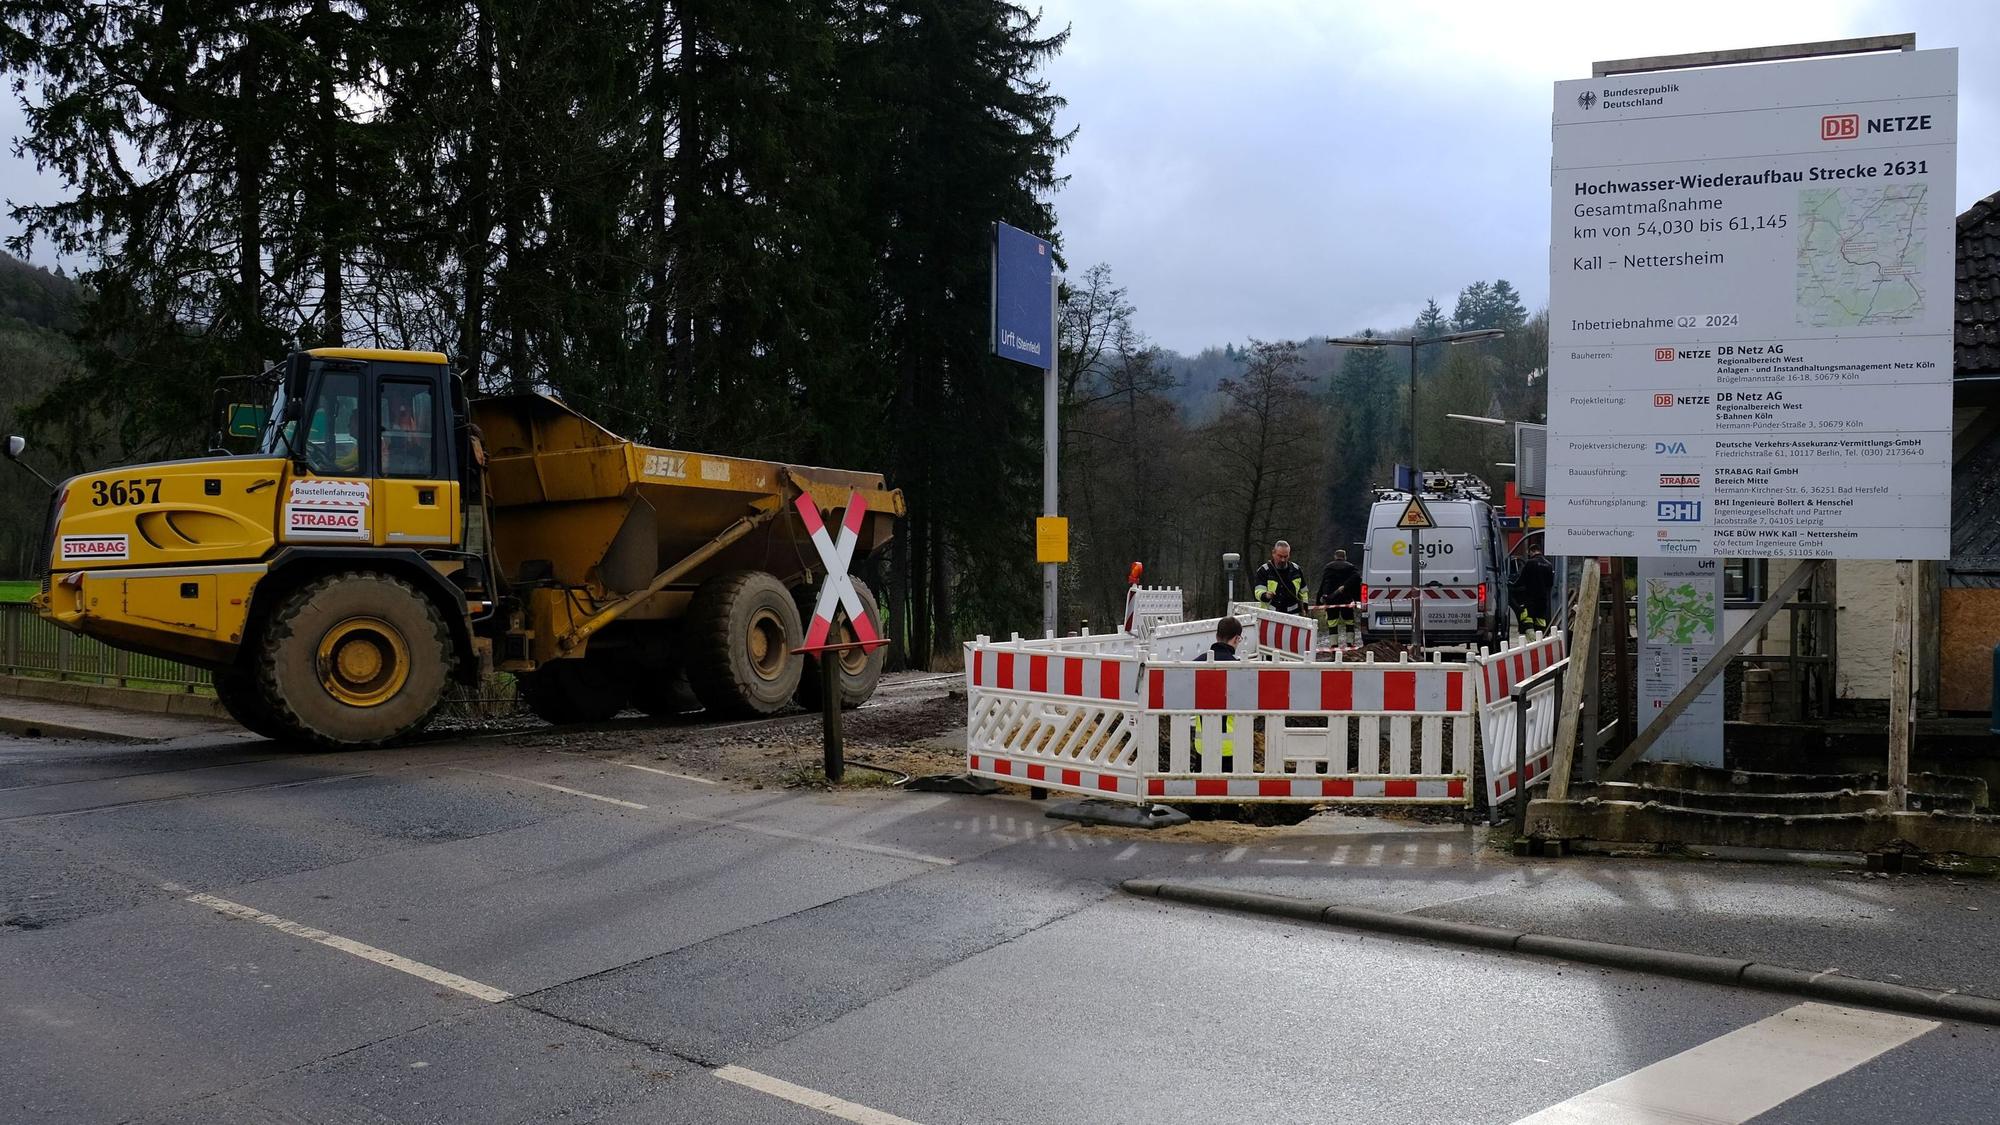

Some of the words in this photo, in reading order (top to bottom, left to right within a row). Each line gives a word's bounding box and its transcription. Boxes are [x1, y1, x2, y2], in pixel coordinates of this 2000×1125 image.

[1603, 84, 1680, 98] Bundesrepublik
[1603, 96, 1663, 110] Deutschland
[1826, 118, 1855, 137] DB
[1866, 115, 1932, 134] NETZE
[1574, 169, 1803, 196] Hochwasser-Wiederaufbau
[1809, 164, 1877, 182] Strecke
[1883, 160, 1929, 176] 2631
[1574, 196, 1723, 218] Gesamtmaßnahme
[1574, 224, 1597, 240] km
[1603, 224, 1631, 238] von
[1636, 219, 1694, 237] 54,030
[1700, 216, 1723, 233] bis
[1728, 213, 1788, 232] 61,145
[1573, 255, 1603, 271] Kall
[1623, 251, 1724, 269] Nettersheim
[1571, 316, 1674, 332] Inbetriebnahme
[1677, 315, 1697, 330] Q2
[1706, 313, 1738, 328] 2024
[1001, 328, 1016, 348] Urft
[1016, 336, 1041, 356] (Steinfeld)
[1657, 350, 1672, 360] DB
[1678, 350, 1711, 358] NETZE
[1718, 346, 1734, 356] DB
[1738, 346, 1764, 355] Netz
[1767, 345, 1784, 354] AG
[1571, 352, 1613, 360] Bauherren:
[1717, 357, 1782, 365] Regionalbereich
[1717, 366, 1749, 374] Anlagen
[1774, 363, 1892, 373] Instandhaltungsmanagement
[1717, 374, 1785, 384] Brügelmannstraße
[1788, 374, 1812, 382] 16-18,
[1815, 373, 1840, 381] 50679
[1656, 396, 1672, 406] DB
[1677, 396, 1710, 404] NETZE
[1717, 393, 1733, 402] DB
[1736, 392, 1763, 401] Netz
[1766, 392, 1783, 401] AG
[1716, 403, 1781, 412] Regionalbereich
[1716, 421, 1806, 430] Hermann-Pünder-Straße
[1846, 420, 1863, 428] Köln
[1569, 442, 1648, 450] Projektversicherung:
[1755, 439, 1921, 448] Verkehrs-Assekuranz-Vermittlungs-GmbH
[1716, 449, 1773, 457] Friedrichstraße
[1775, 450, 1788, 458] 61,
[1790, 449, 1814, 457] 10117
[1817, 449, 1842, 458] Berlin,
[1861, 448, 1883, 457] (030)
[1886, 448, 1924, 456] 217364-0
[643, 454, 687, 480] BELL
[1715, 477, 1745, 485] Bereich
[91, 478, 162, 507] 3657
[294, 487, 366, 501] Baustellenfahrzeug
[1715, 486, 1799, 494] Hermann-Kirchner-Str.
[1811, 486, 1835, 494] 36251
[1838, 486, 1852, 494] Bad
[1855, 486, 1888, 494] Hersfeld
[1732, 499, 1775, 507] Ingenieure
[1714, 508, 1794, 516] Ingenieurgesellschaft
[1797, 508, 1810, 516] und
[1814, 508, 1842, 516] Partner
[291, 512, 359, 528] STRABAG
[1714, 517, 1758, 525] Jacobstraße
[1760, 518, 1767, 526] 7,
[1796, 517, 1824, 526] Leipzig
[1568, 529, 1635, 537] Bauüberwachung:
[1737, 529, 1756, 537] BÜW
[64, 541, 126, 554] STRABAG
[1666, 543, 1697, 552] fectum
[1756, 540, 1796, 548] Ingenieure
[1738, 549, 1772, 558] Kirchweg
[1774, 549, 1787, 557] 65,
[1698, 560, 1715, 568] Urft
